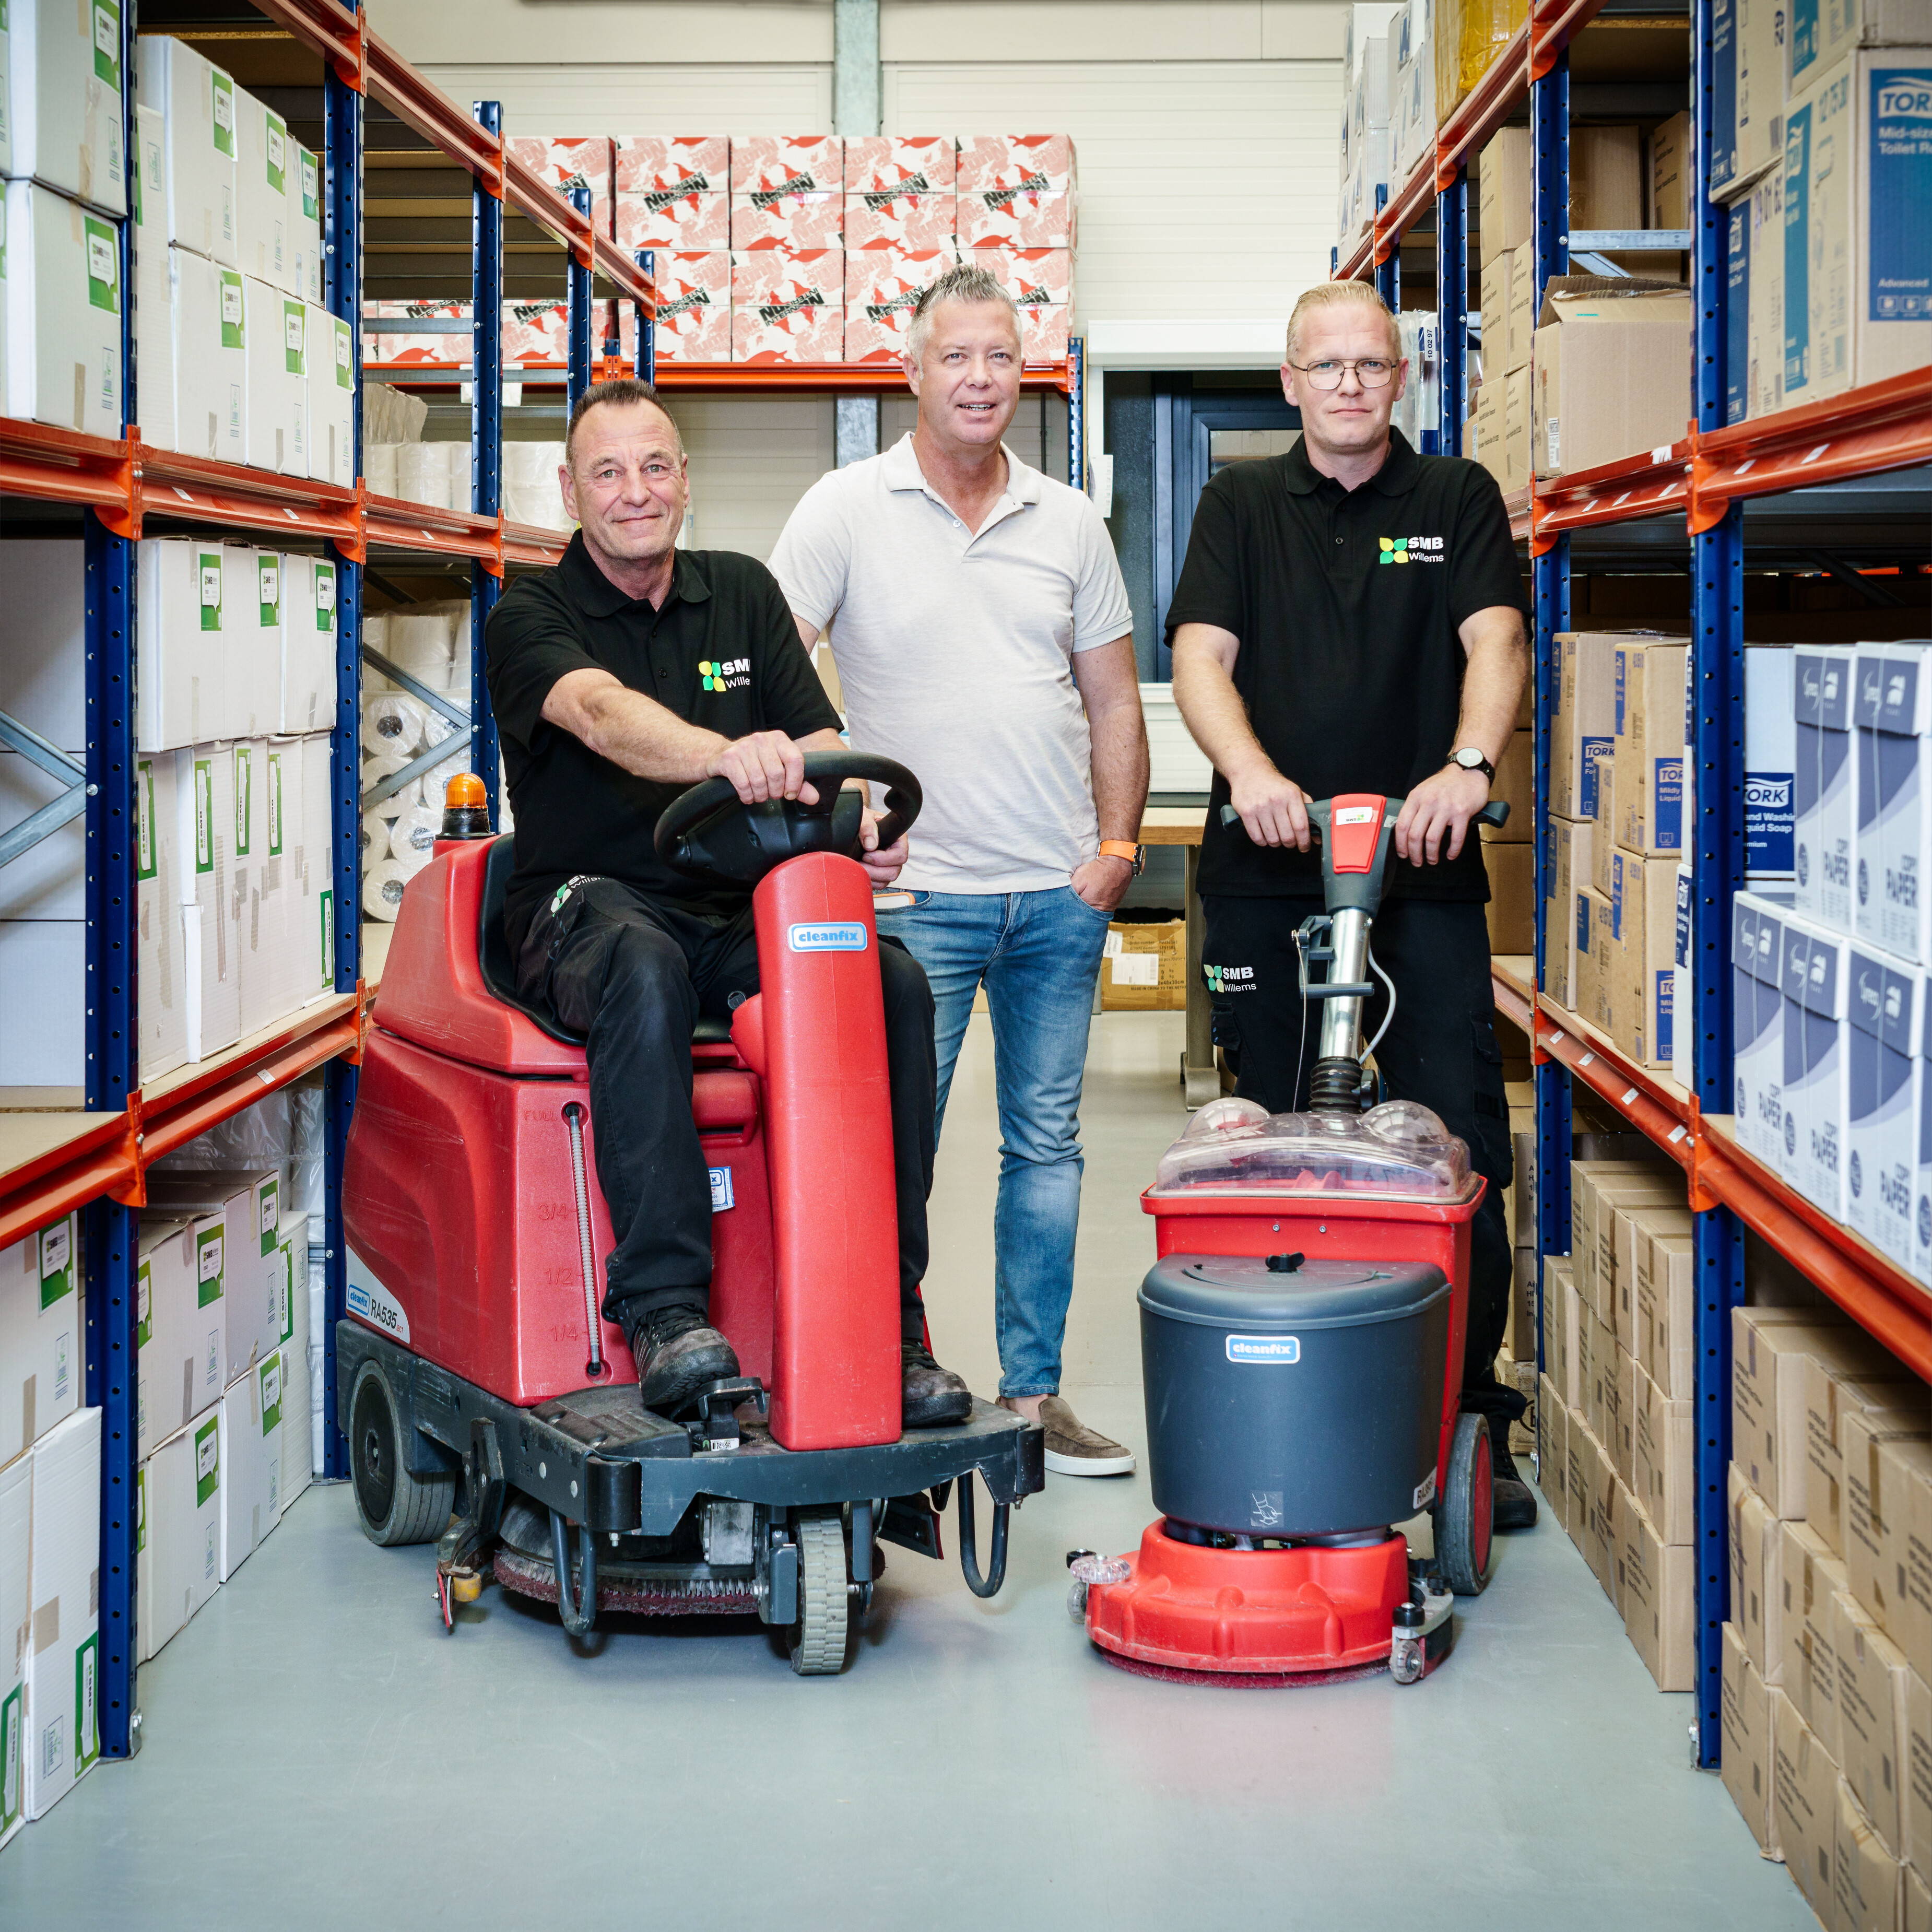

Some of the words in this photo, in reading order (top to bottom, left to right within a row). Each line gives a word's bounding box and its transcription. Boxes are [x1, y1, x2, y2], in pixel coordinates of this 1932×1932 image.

[1883, 92, 1931, 112] TOR
[1427, 329, 1432, 338] 97
[1427, 339, 1433, 348] 02
[1428, 350, 1433, 359] 10
[1408, 536, 1444, 550] SMB
[1408, 552, 1444, 563] Willems
[722, 658, 750, 675] SM
[1587, 747, 1615, 756] TORK
[1746, 789, 1785, 802] ORK
[1746, 823, 1765, 833] quid
[1766, 823, 1793, 834] Soap
[798, 930, 858, 943] cleanfix
[1223, 967, 1254, 980] SMB
[1224, 982, 1257, 993] Willems
[525, 1110, 558, 1121] FULL
[538, 1203, 569, 1220] 3/4
[545, 1267, 573, 1285] 1/2
[350, 1292, 368, 1307] cleanfix
[371, 1299, 397, 1329] RA535
[550, 1324, 578, 1341] 1/4
[1233, 1341, 1292, 1354] cleanfix
